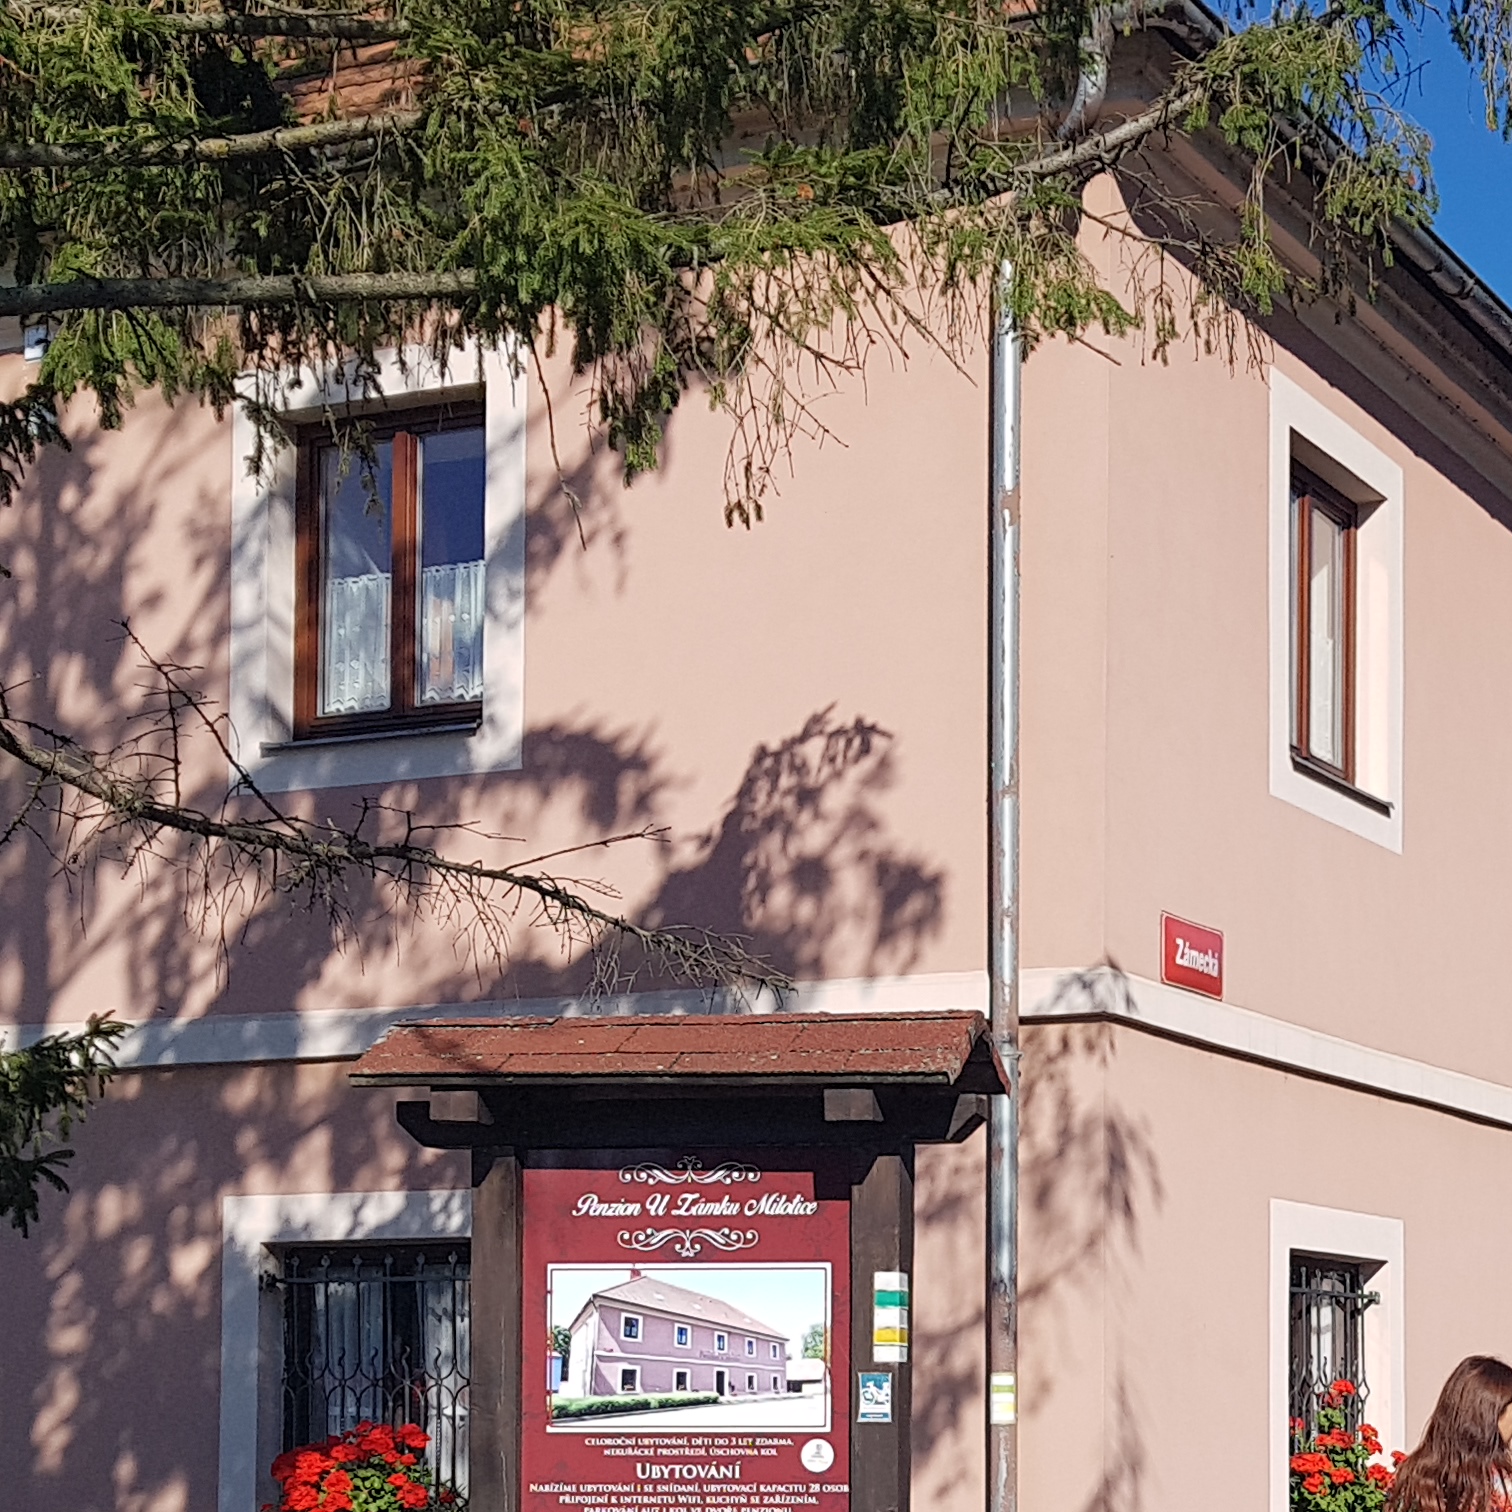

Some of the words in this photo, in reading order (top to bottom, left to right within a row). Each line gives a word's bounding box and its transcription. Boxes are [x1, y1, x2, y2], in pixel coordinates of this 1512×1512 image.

[571, 1193, 642, 1217] Penzion
[743, 1192, 818, 1217] Milotice
[636, 1460, 741, 1480] UBYTOVÁNÍ
